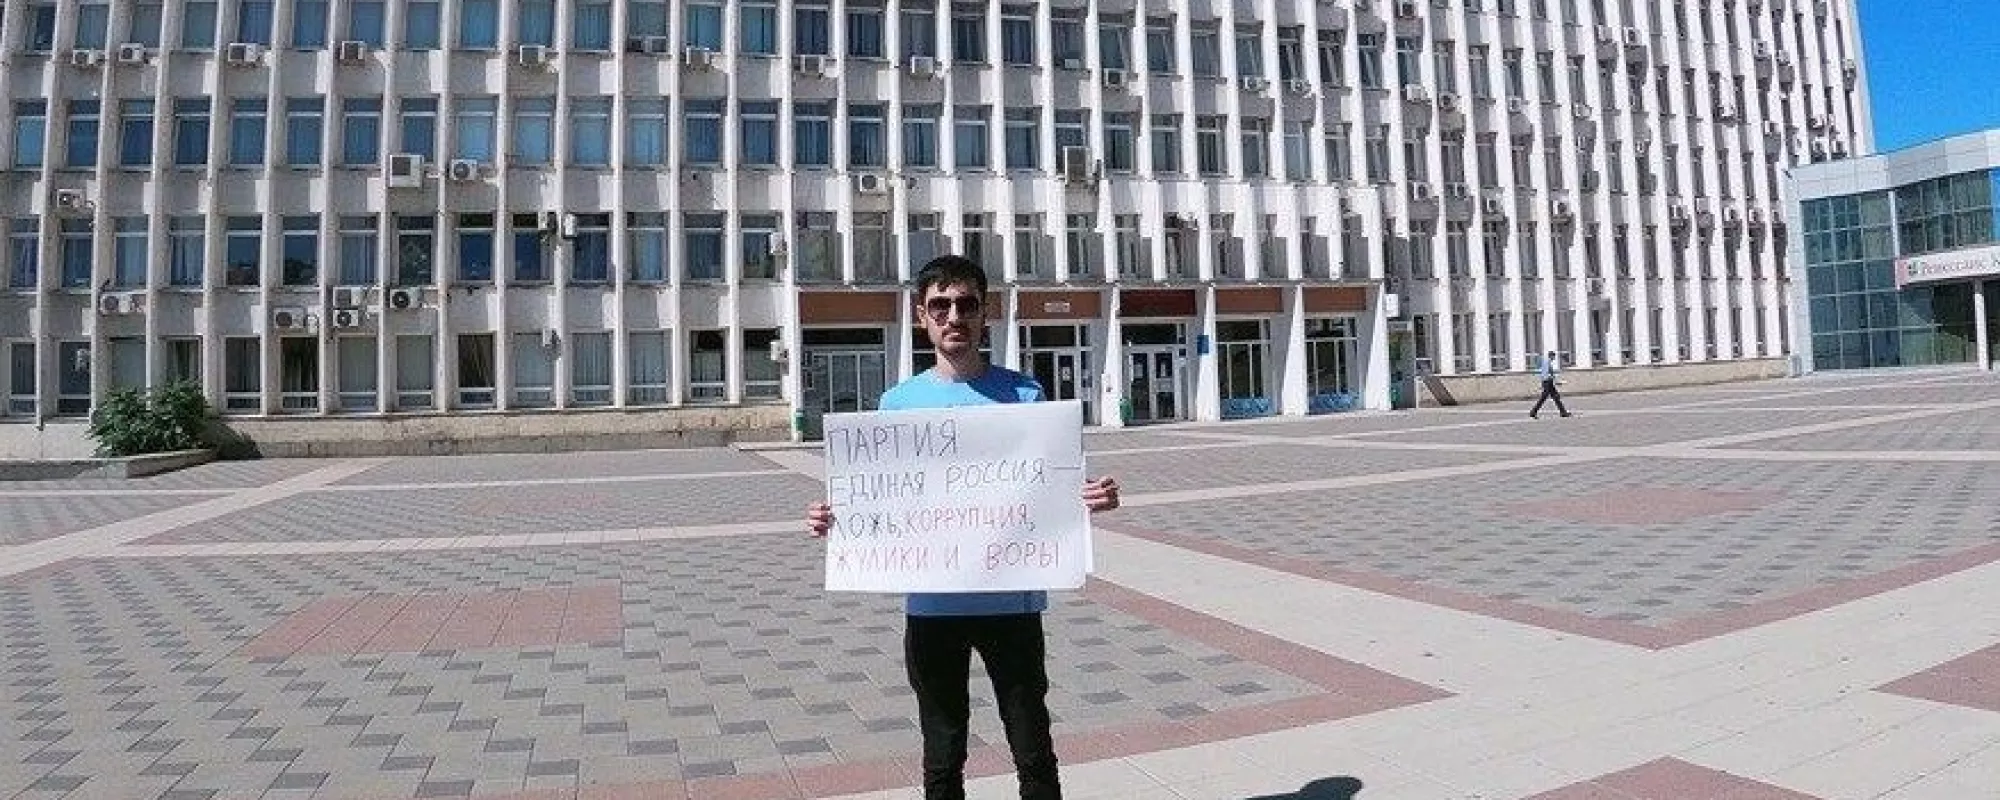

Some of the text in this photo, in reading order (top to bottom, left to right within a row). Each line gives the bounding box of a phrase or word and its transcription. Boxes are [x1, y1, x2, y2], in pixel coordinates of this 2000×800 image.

[828, 419, 957, 466] ПАРТИЯ
[829, 471, 925, 506] ЕДИНАЯ
[945, 458, 1045, 494] РОССИЯ
[905, 502, 1036, 534] КОРРУПЦИЯ,
[836, 541, 1059, 572] ЖУЛИКИ И ВОРЫ
